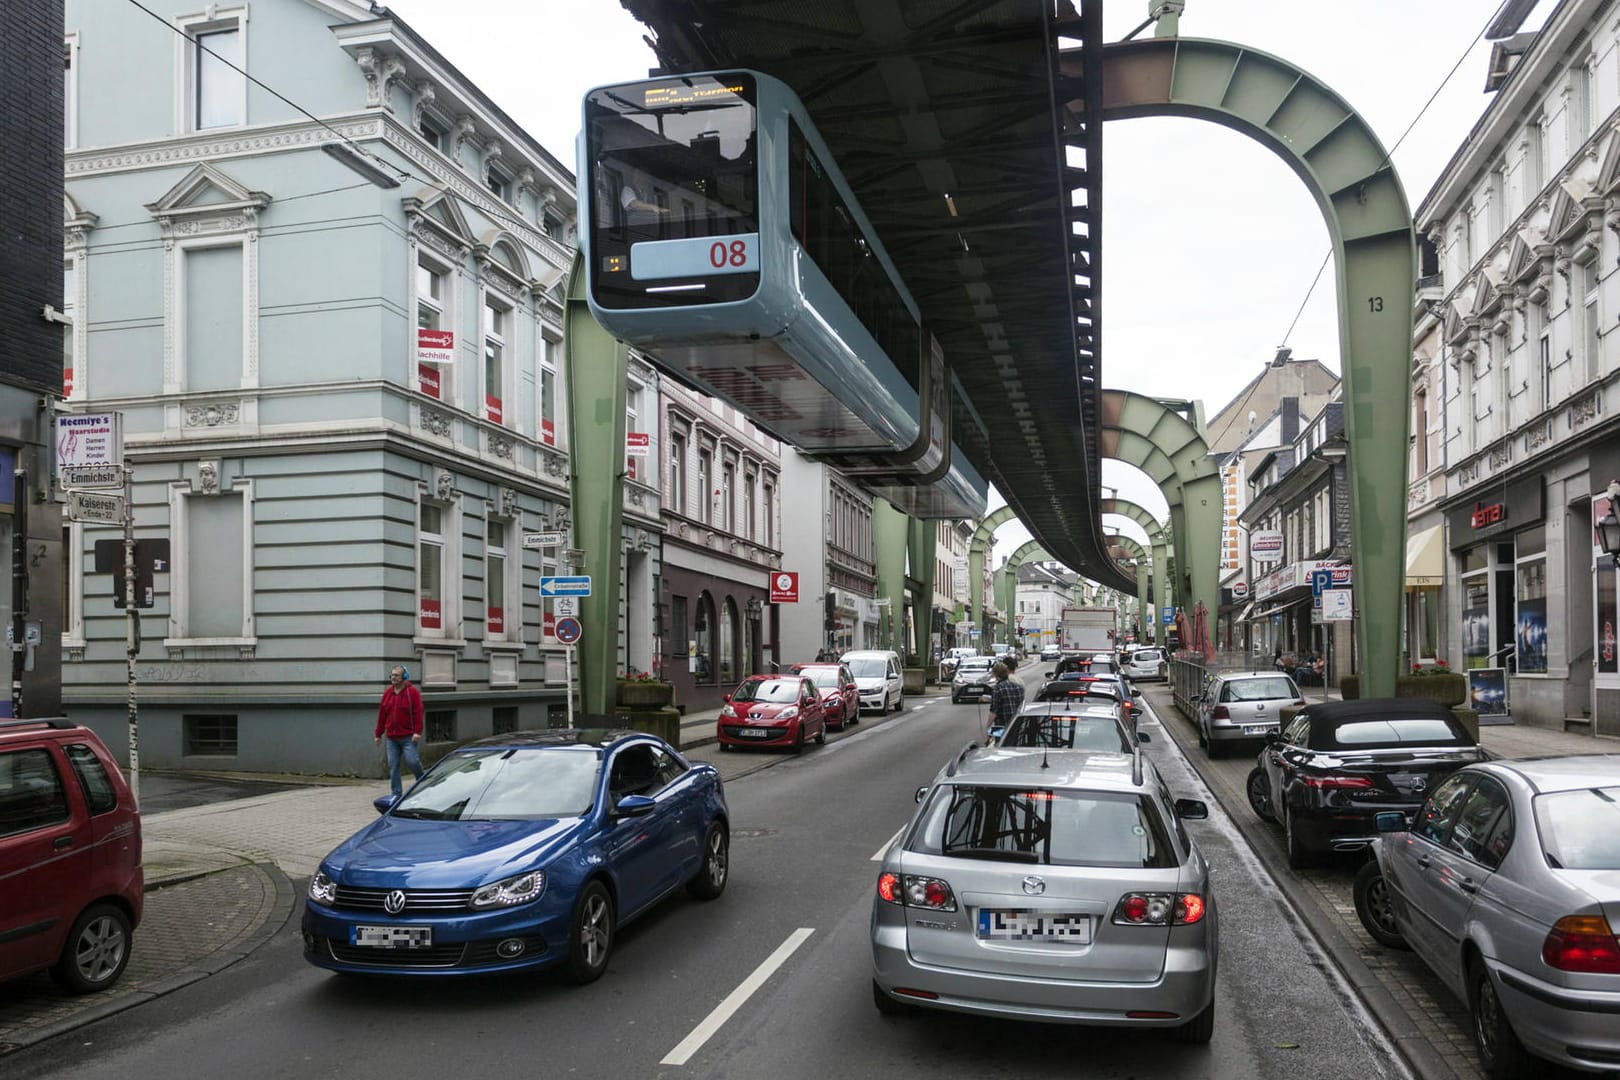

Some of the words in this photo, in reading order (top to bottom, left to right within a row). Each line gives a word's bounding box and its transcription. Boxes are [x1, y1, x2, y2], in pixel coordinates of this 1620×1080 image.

[710, 240, 746, 268] 08
[1368, 296, 1383, 312] 13
[418, 350, 451, 360] achhilfe
[1317, 574, 1328, 593] P
